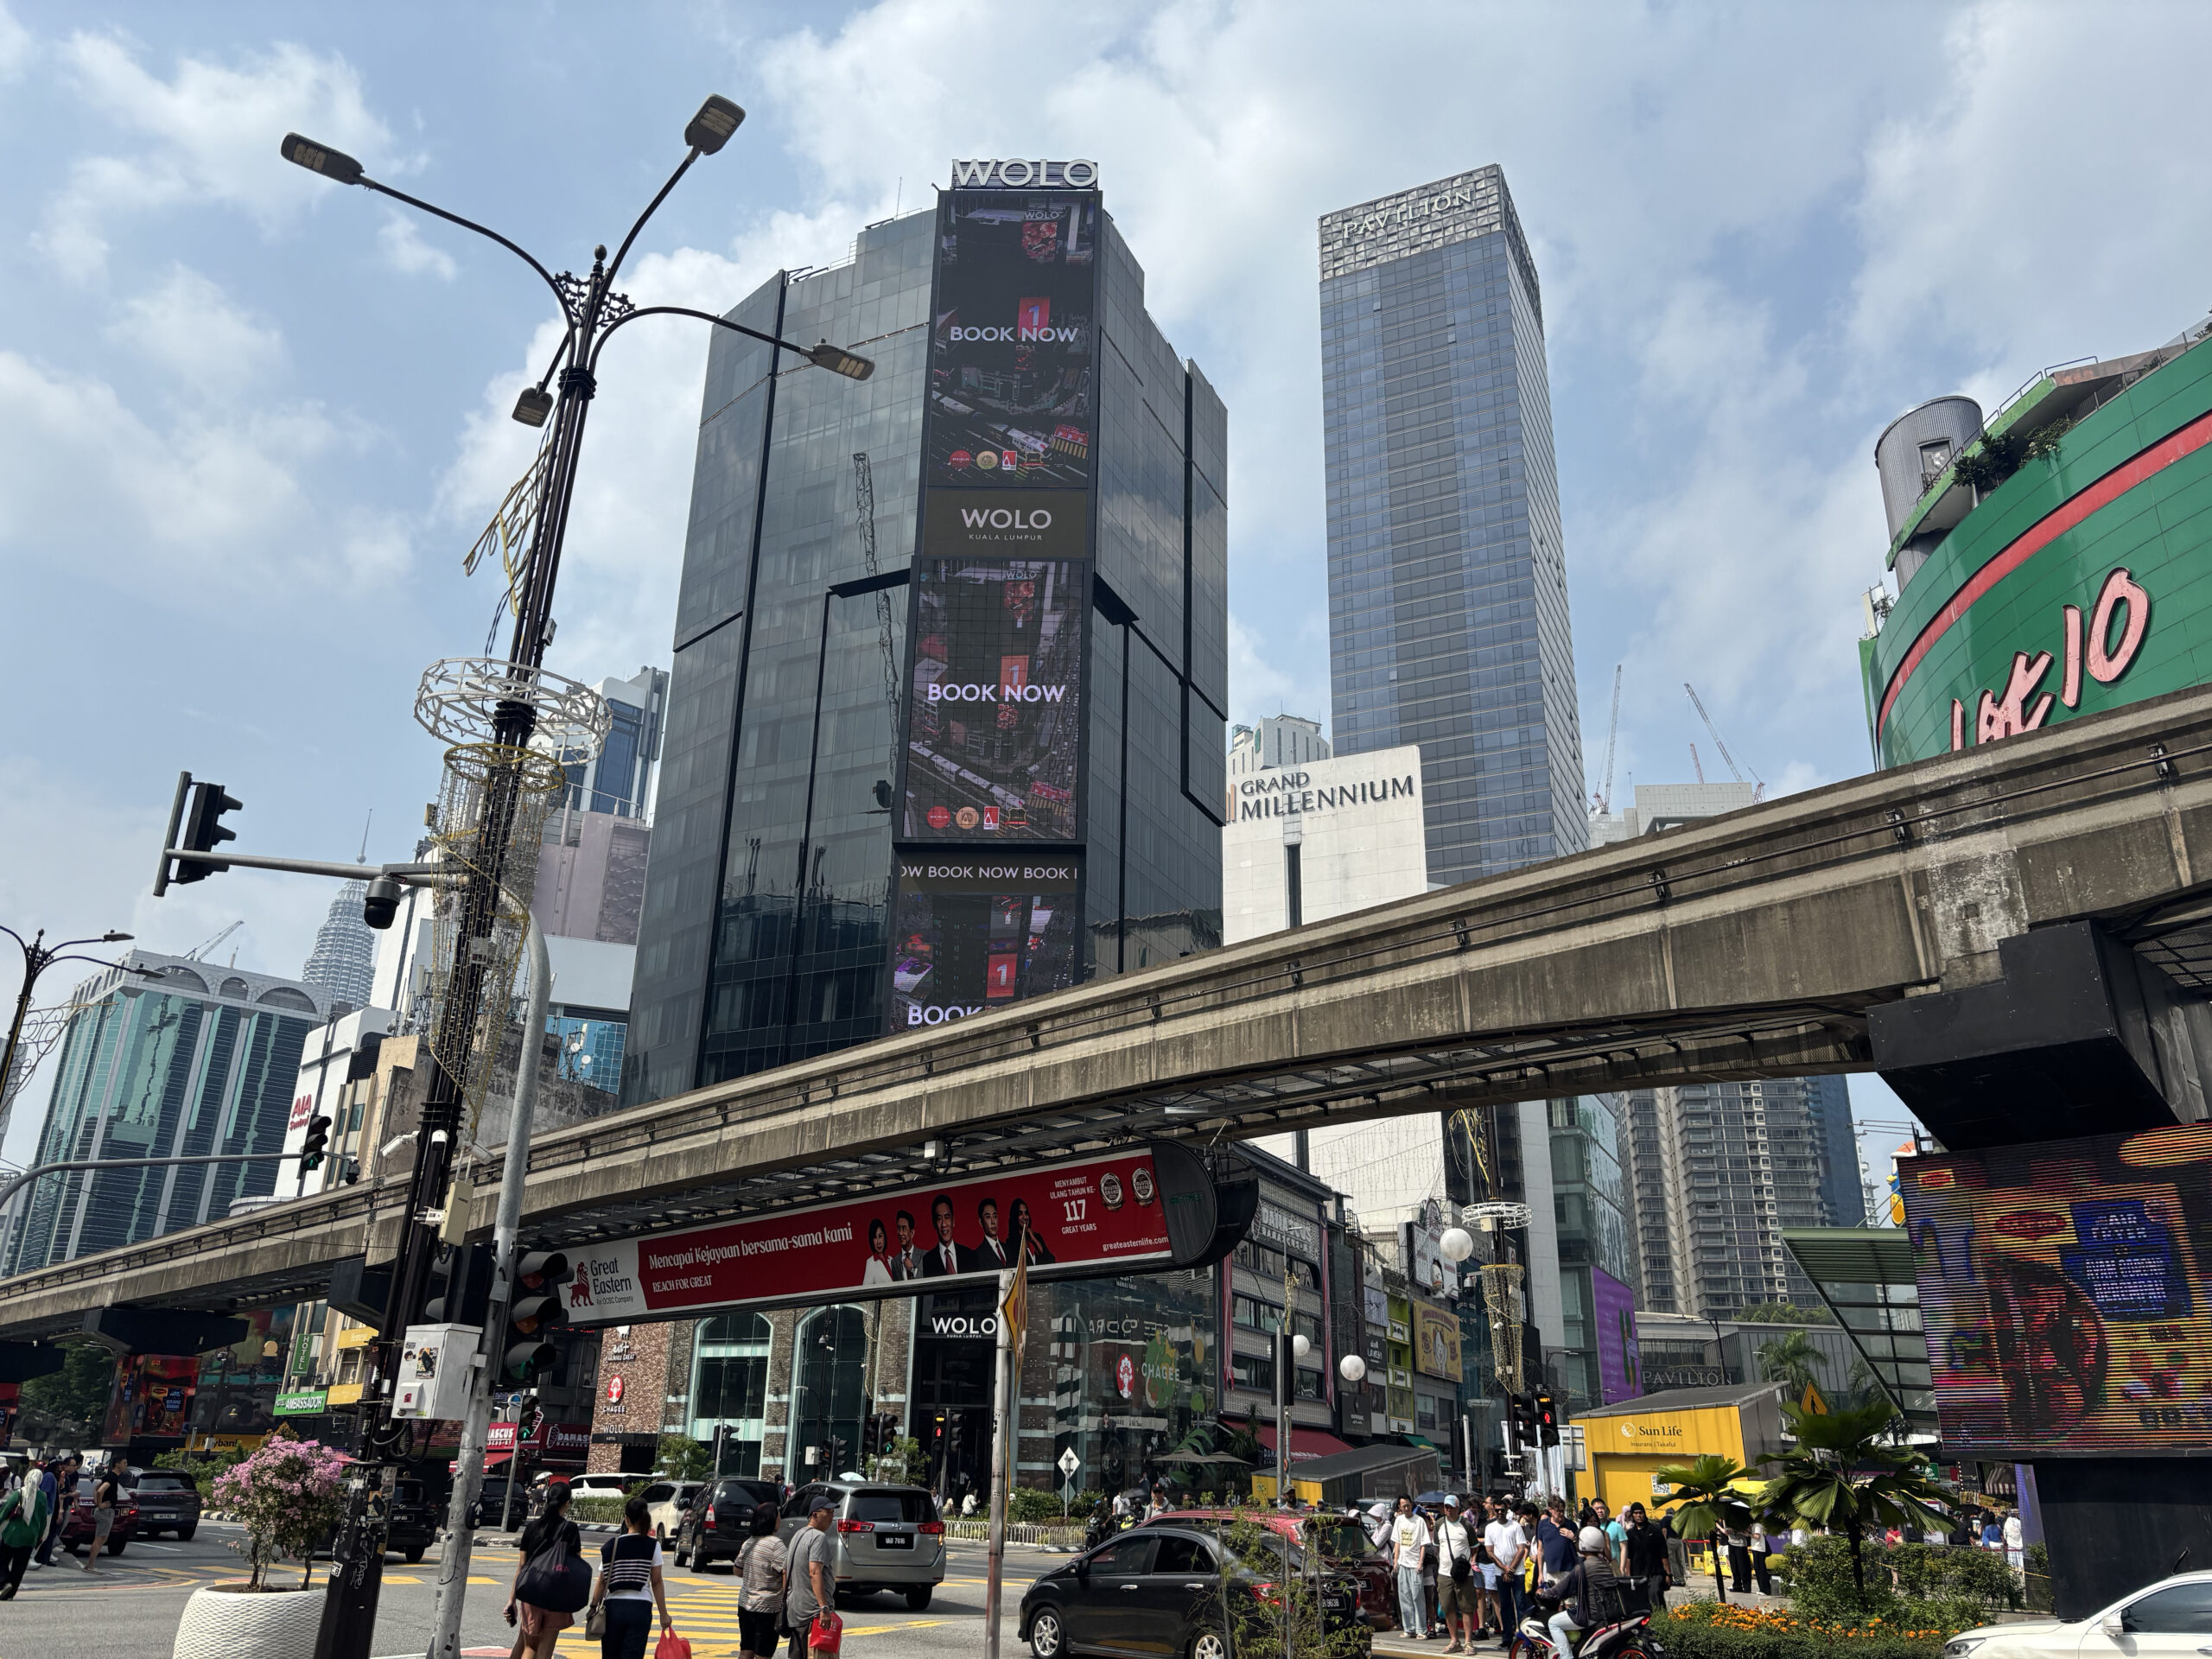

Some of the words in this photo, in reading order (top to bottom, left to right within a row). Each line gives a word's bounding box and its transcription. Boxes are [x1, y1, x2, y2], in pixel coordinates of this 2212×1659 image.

[952, 158, 1097, 187] WOLO
[1343, 188, 1474, 238] PAVILION
[950, 327, 1014, 342] BOOK
[1021, 327, 1078, 342] NOW
[961, 508, 1052, 529] WOLO
[927, 683, 996, 702] BOOK
[1005, 684, 1066, 702] NOW
[1241, 772, 1310, 795] GRAND
[1241, 775, 1414, 820] MILLENNIUM
[928, 866, 974, 878] BOOK
[978, 867, 1019, 879] NOW
[1024, 867, 1069, 880] BOOK
[291, 1094, 312, 1118] AIA
[1054, 1176, 1087, 1188] MENYAMBUT
[1050, 1189, 1067, 1199] ULANG
[1068, 1188, 1086, 1198] TAHUN
[1063, 1198, 1086, 1222] 117
[1061, 1224, 1079, 1235] GREAT
[1080, 1223, 1096, 1233] YEARS
[649, 1248, 694, 1270] Mencapai
[695, 1242, 740, 1266] Kejayaan
[741, 1228, 822, 1255] bersama-sama
[823, 1222, 853, 1245] kami
[1102, 1236, 1169, 1252] greateasternlife.com
[590, 1256, 620, 1277] Great
[593, 1274, 632, 1296] Eastern
[652, 1281, 675, 1294] REACH
[675, 1277, 690, 1290] FOR
[690, 1274, 712, 1288] GREAT
[615, 1295, 633, 1306] Company
[931, 1317, 997, 1334] WOLO
[298, 1336, 309, 1370] HOTEL
[1141, 1363, 1180, 1382] CHAGEE
[285, 1396, 323, 1410] AMBASSADOR
[604, 1424, 623, 1433] WOLO
[1639, 1426, 1660, 1436] Sun
[1662, 1426, 1682, 1436] Life
